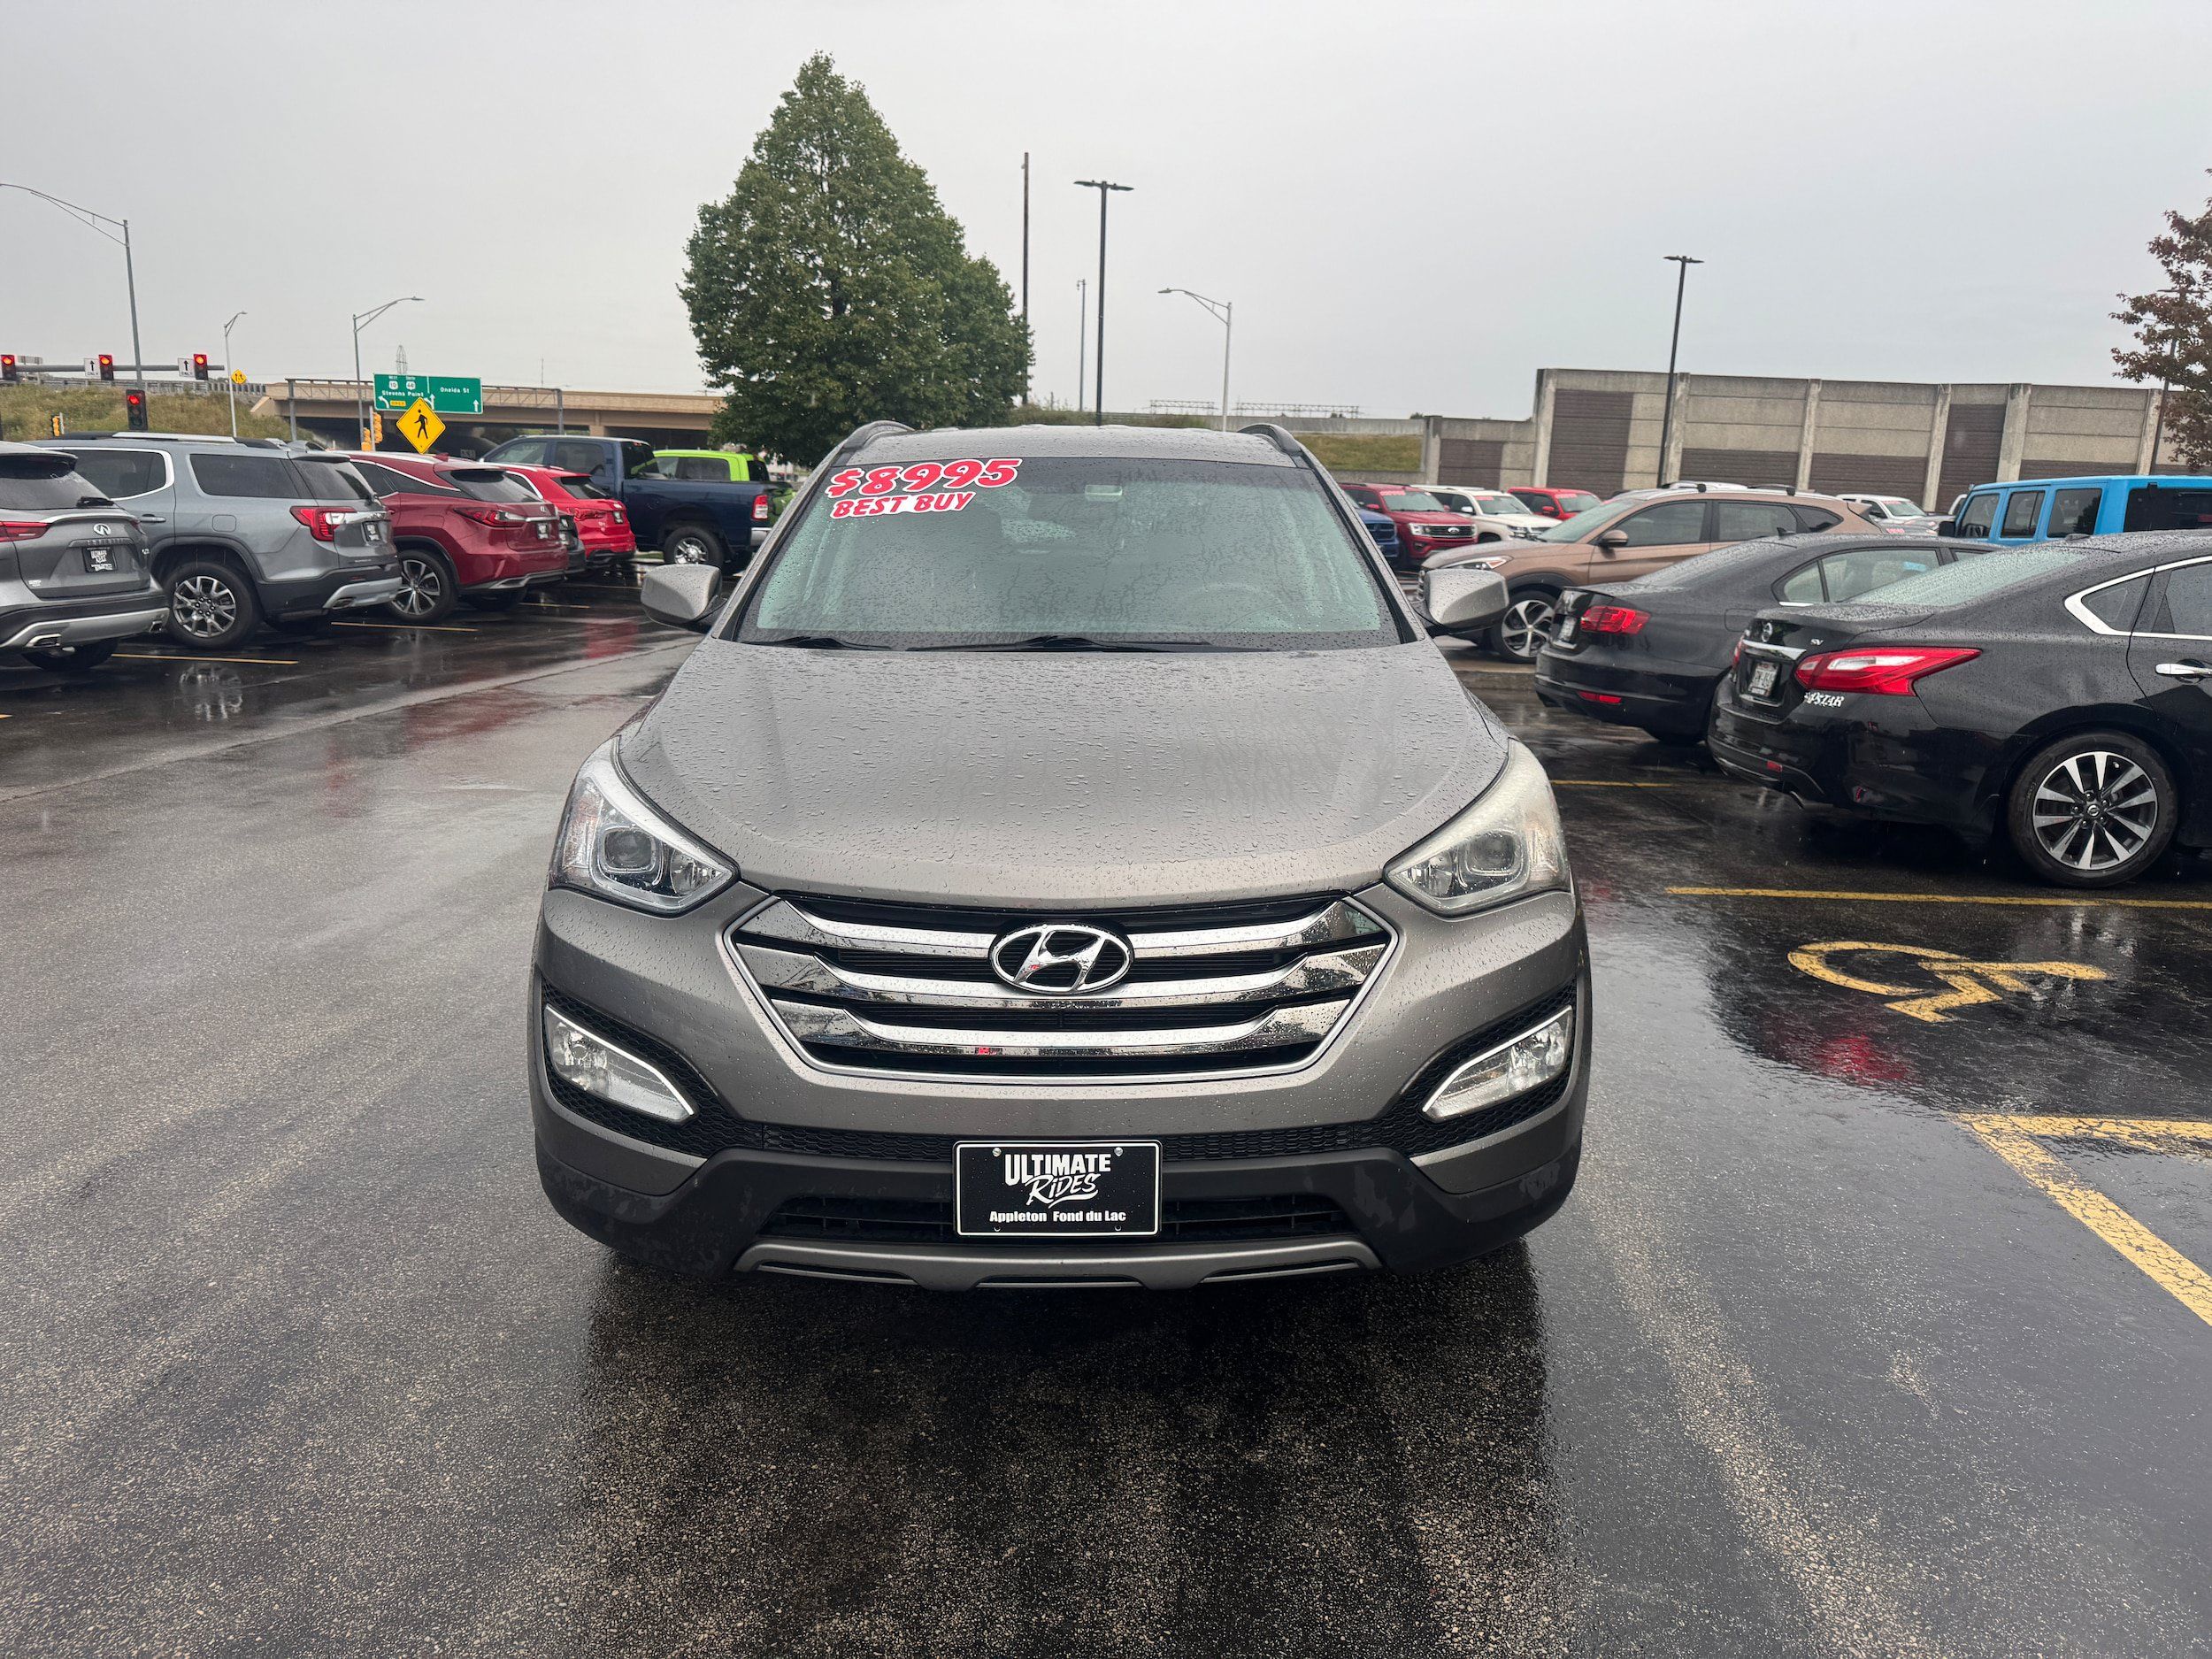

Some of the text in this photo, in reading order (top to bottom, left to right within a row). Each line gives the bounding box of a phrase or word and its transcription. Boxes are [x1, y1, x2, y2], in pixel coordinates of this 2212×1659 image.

[825, 458, 1022, 498] $8995
[830, 492, 976, 518] BEST BUY
[1004, 1154, 1111, 1187] ULTIMATE
[989, 1210, 1126, 1223] Appleton Fond du Lac
